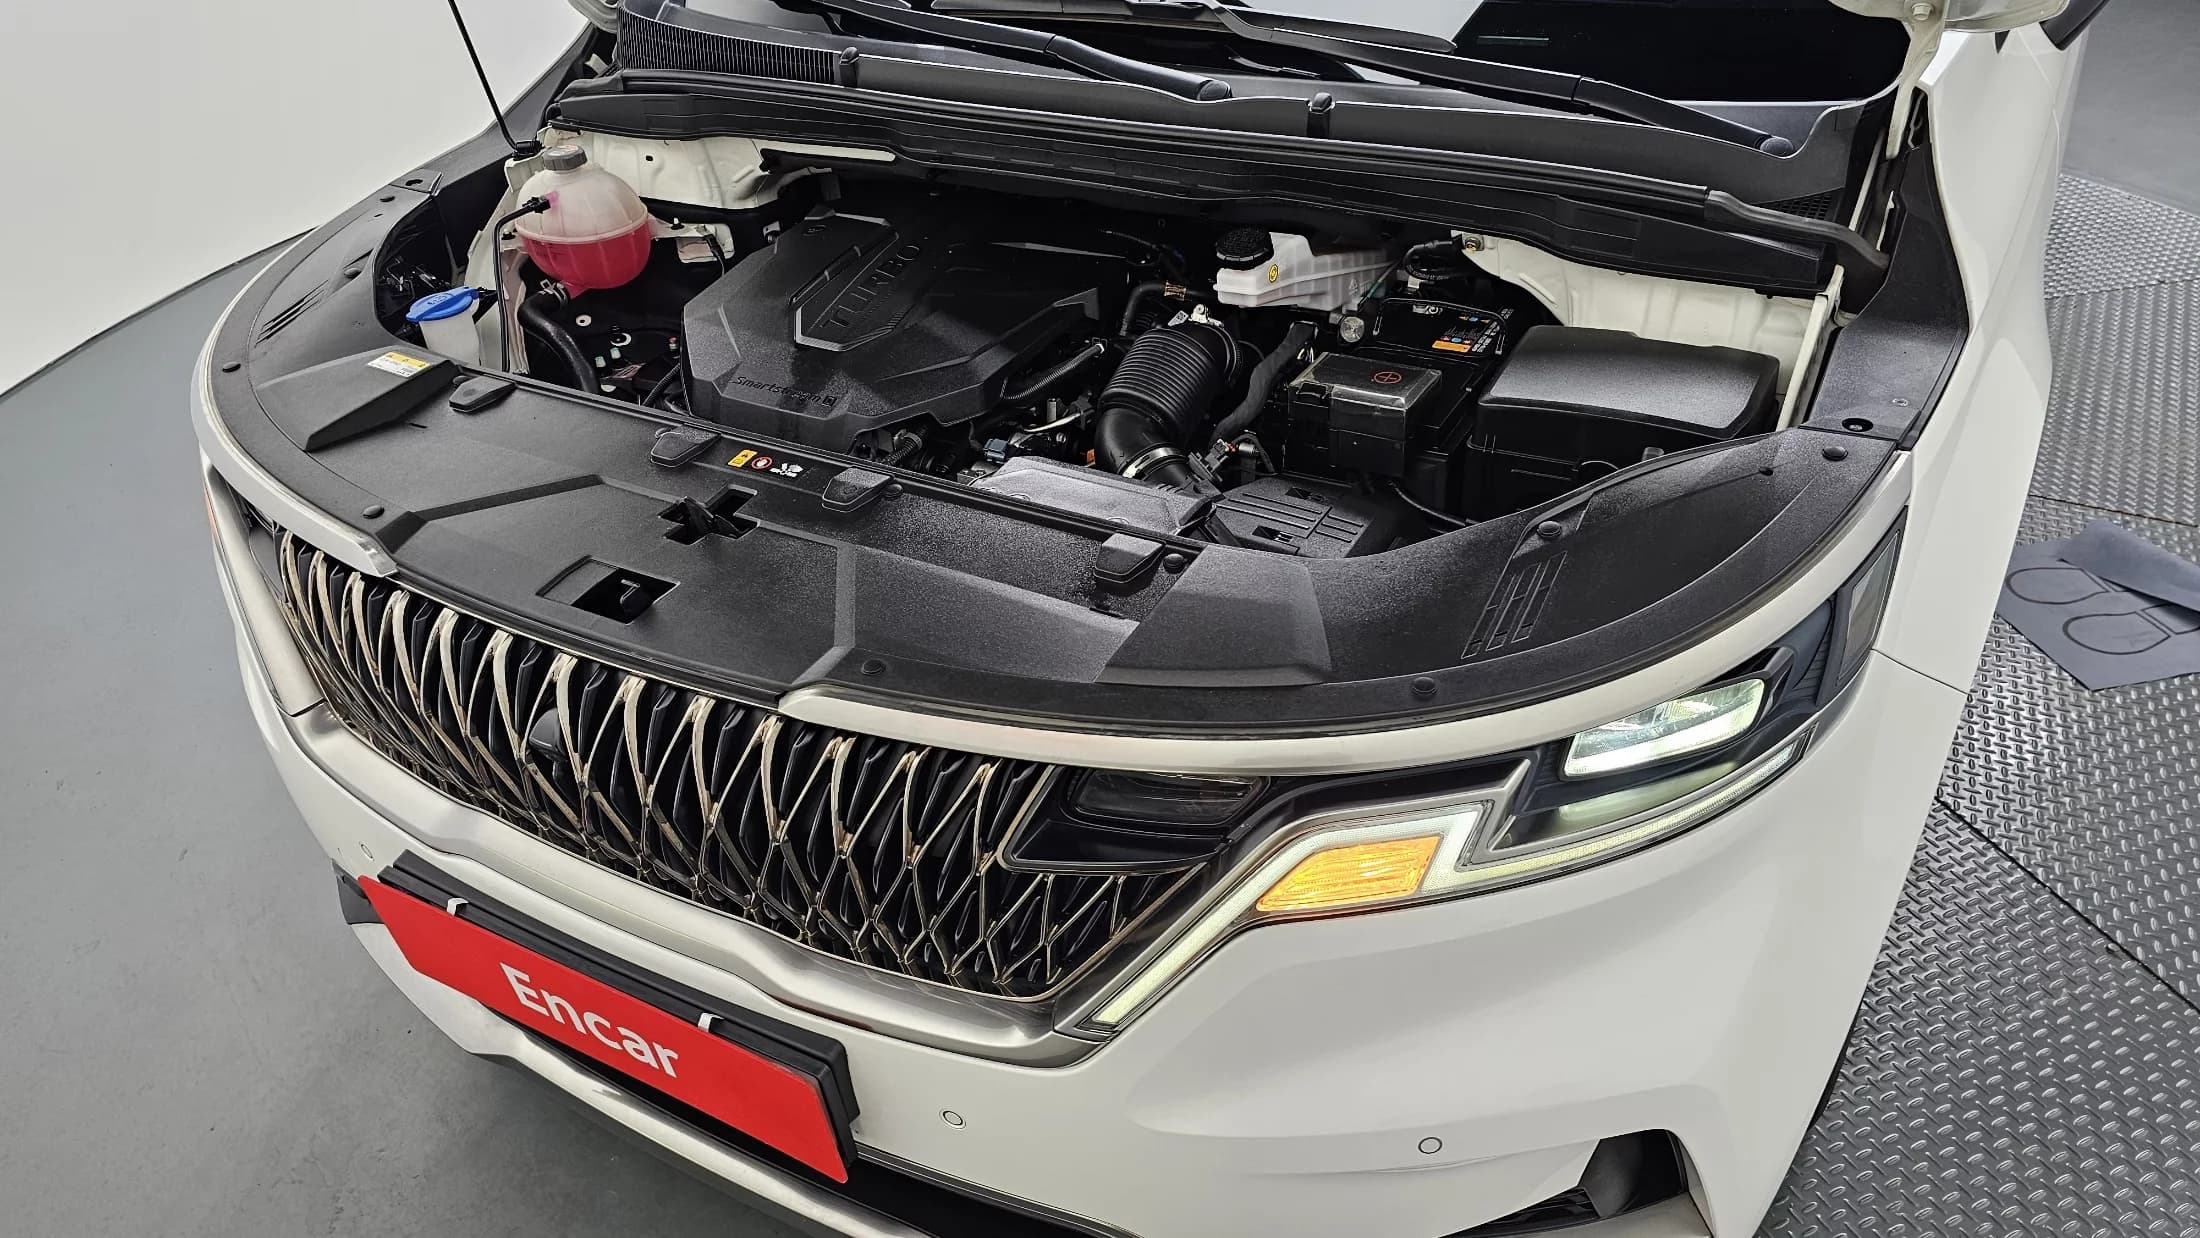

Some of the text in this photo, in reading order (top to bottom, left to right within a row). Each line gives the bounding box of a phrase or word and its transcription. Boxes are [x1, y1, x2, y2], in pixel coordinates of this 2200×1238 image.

[819, 245, 920, 328] TURBO
[735, 376, 821, 402] Smartstream
[500, 962, 680, 1078] Encar
